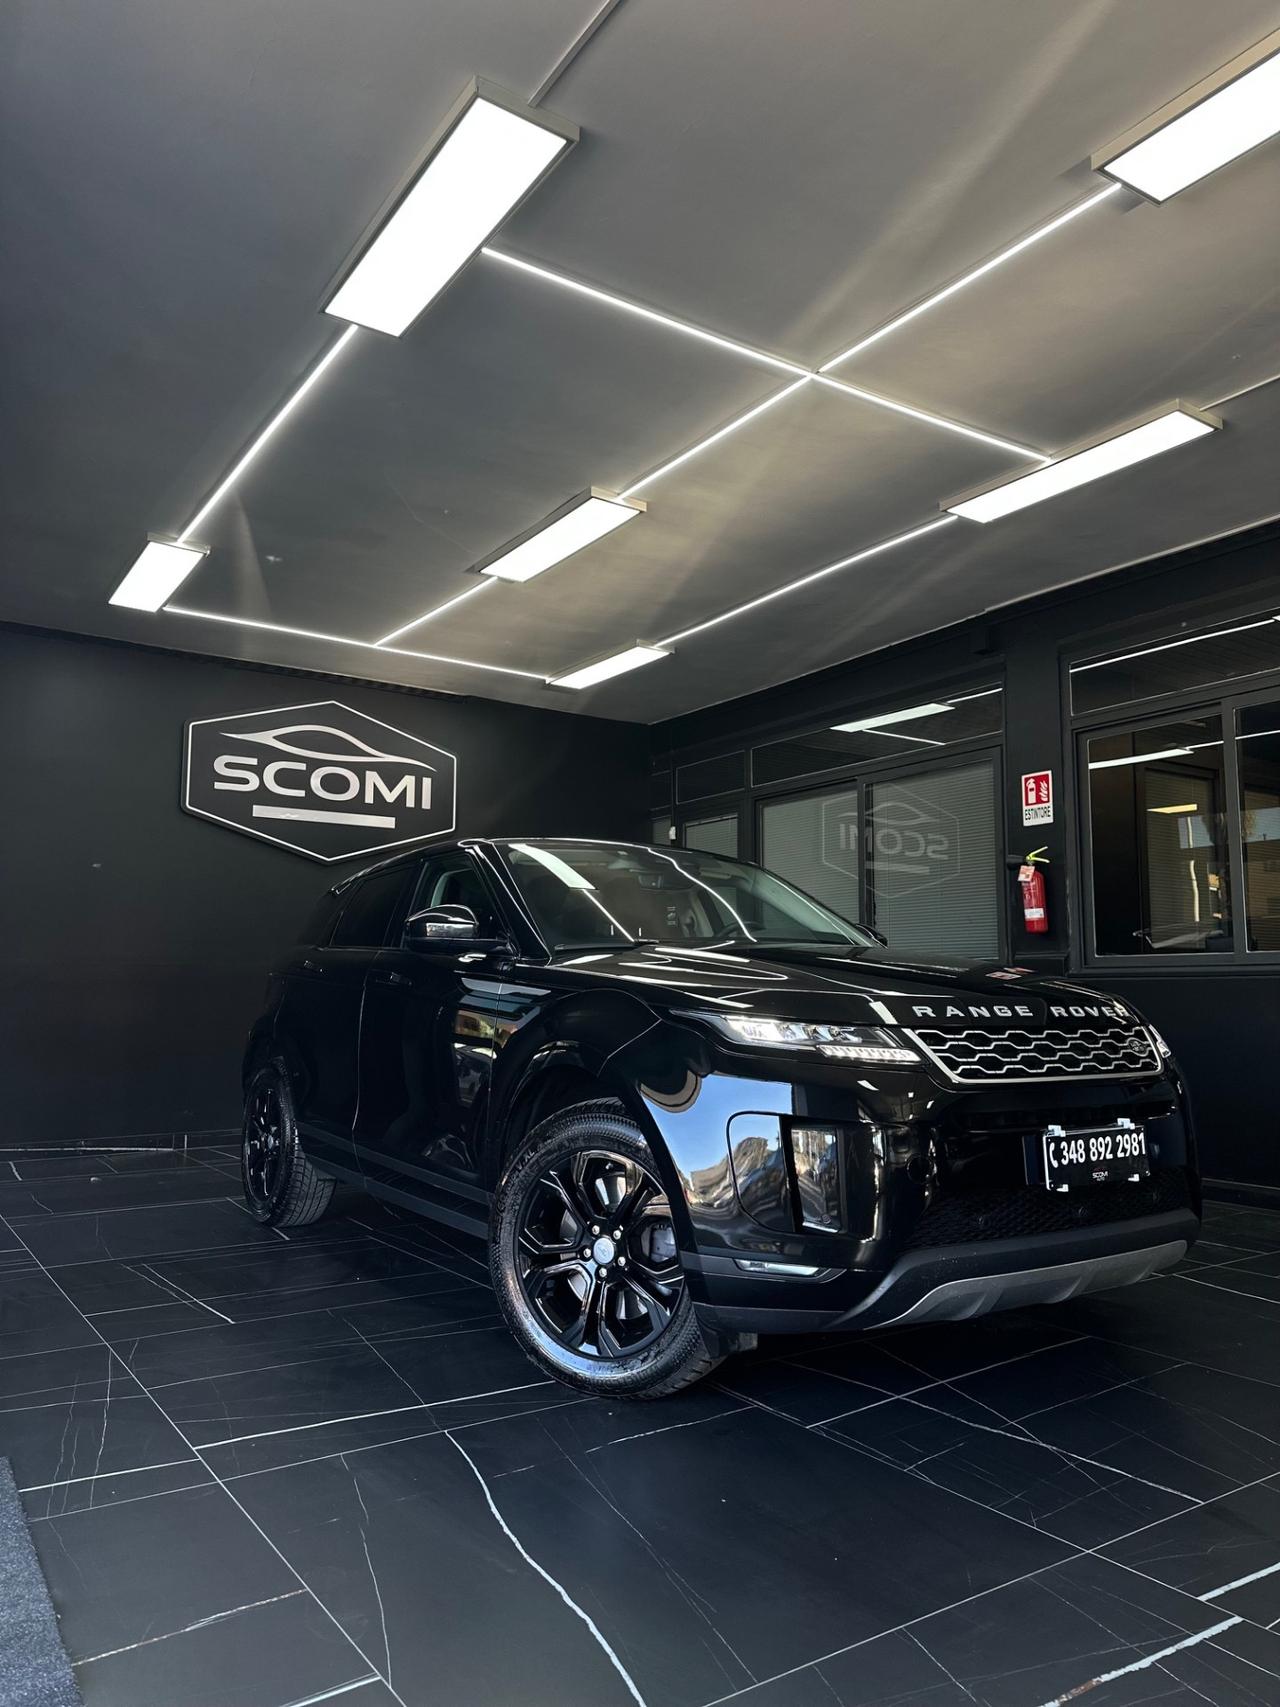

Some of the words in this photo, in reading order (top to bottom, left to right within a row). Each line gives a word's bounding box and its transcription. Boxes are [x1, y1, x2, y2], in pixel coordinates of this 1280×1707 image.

[213, 755, 432, 809] SCOMI
[1025, 806, 1051, 820] ESTINTORE
[912, 1005, 1034, 1018] RANGE
[1050, 1006, 1130, 1018] ROVER
[1060, 1139, 1085, 1166] 348
[1090, 1136, 1113, 1162] 892
[1116, 1132, 1146, 1158] 2981
